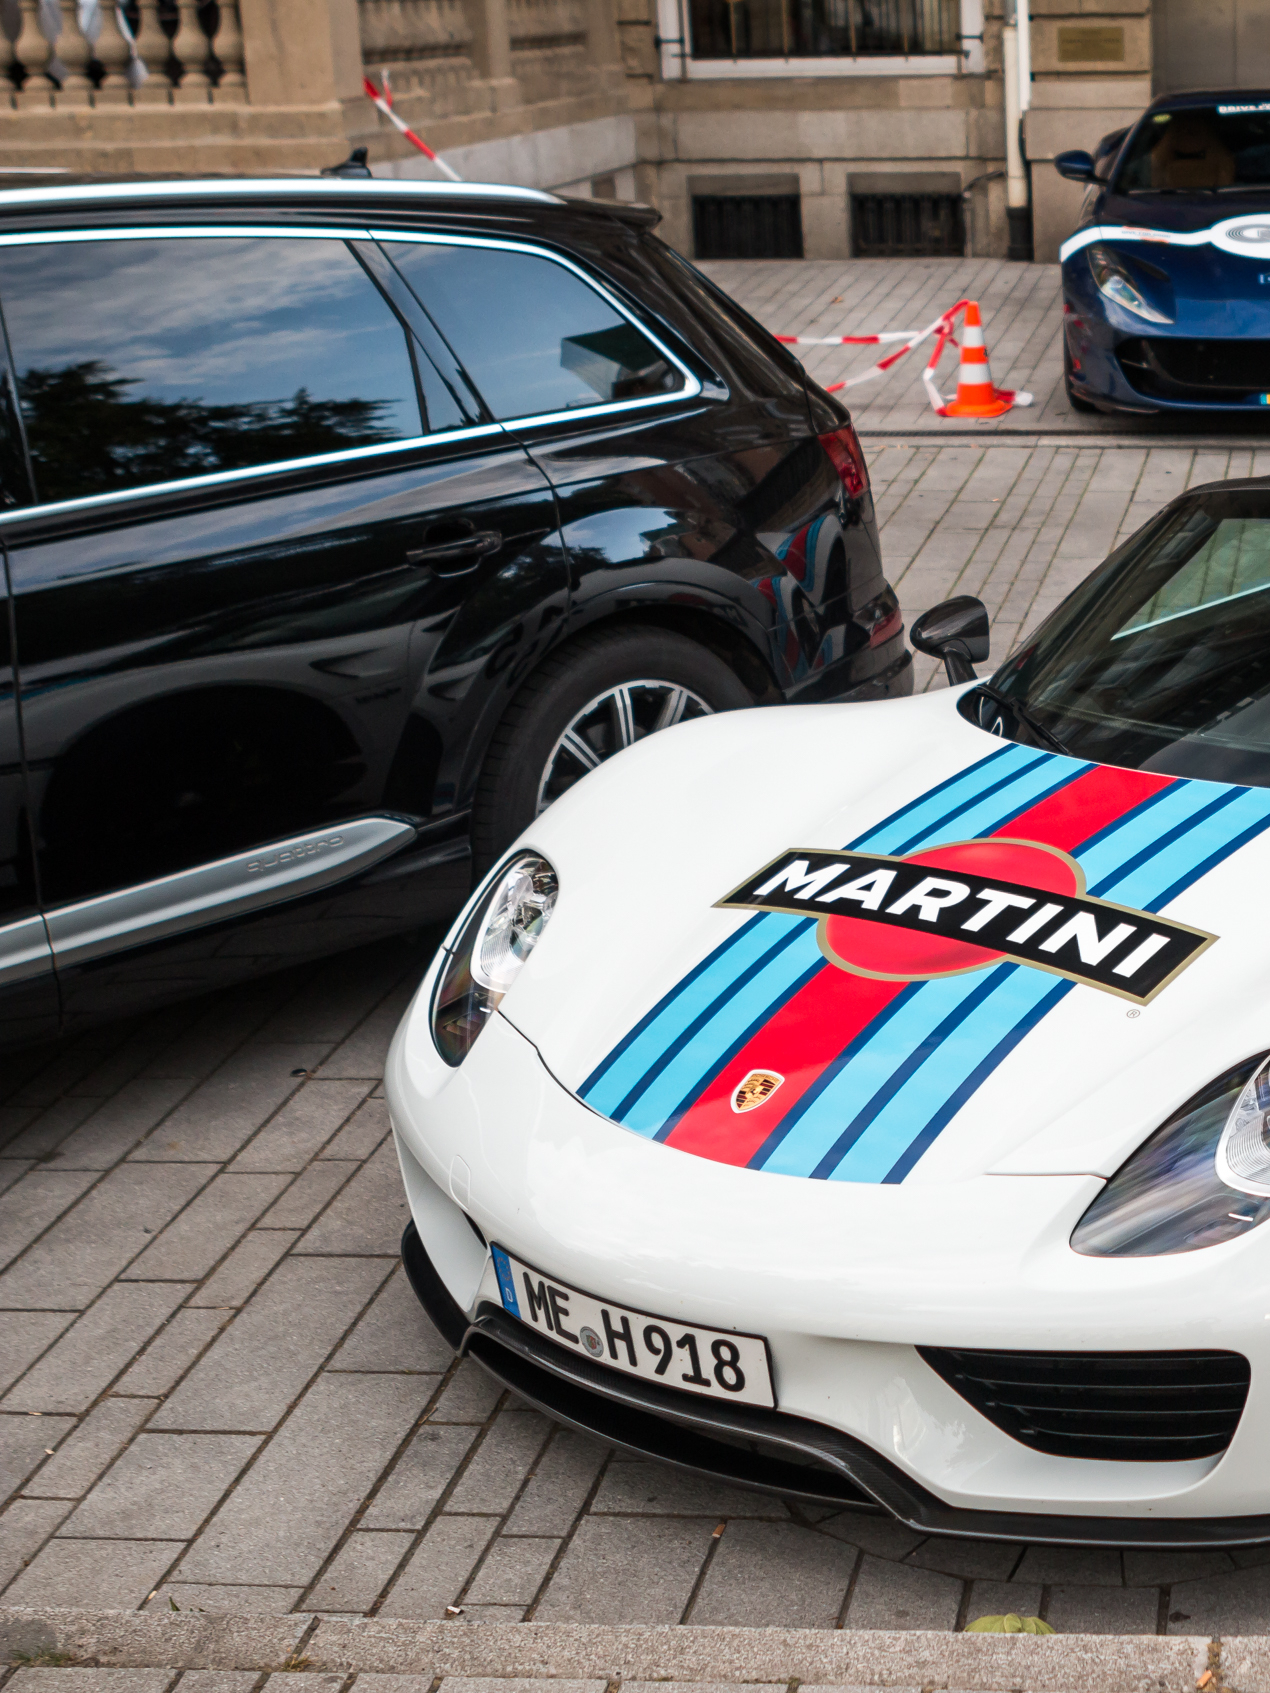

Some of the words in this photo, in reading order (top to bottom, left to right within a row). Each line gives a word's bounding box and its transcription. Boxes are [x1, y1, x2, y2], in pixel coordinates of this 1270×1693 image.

[247, 836, 344, 872] quattro
[752, 859, 1171, 978] MARTINI
[523, 1272, 580, 1345] ME
